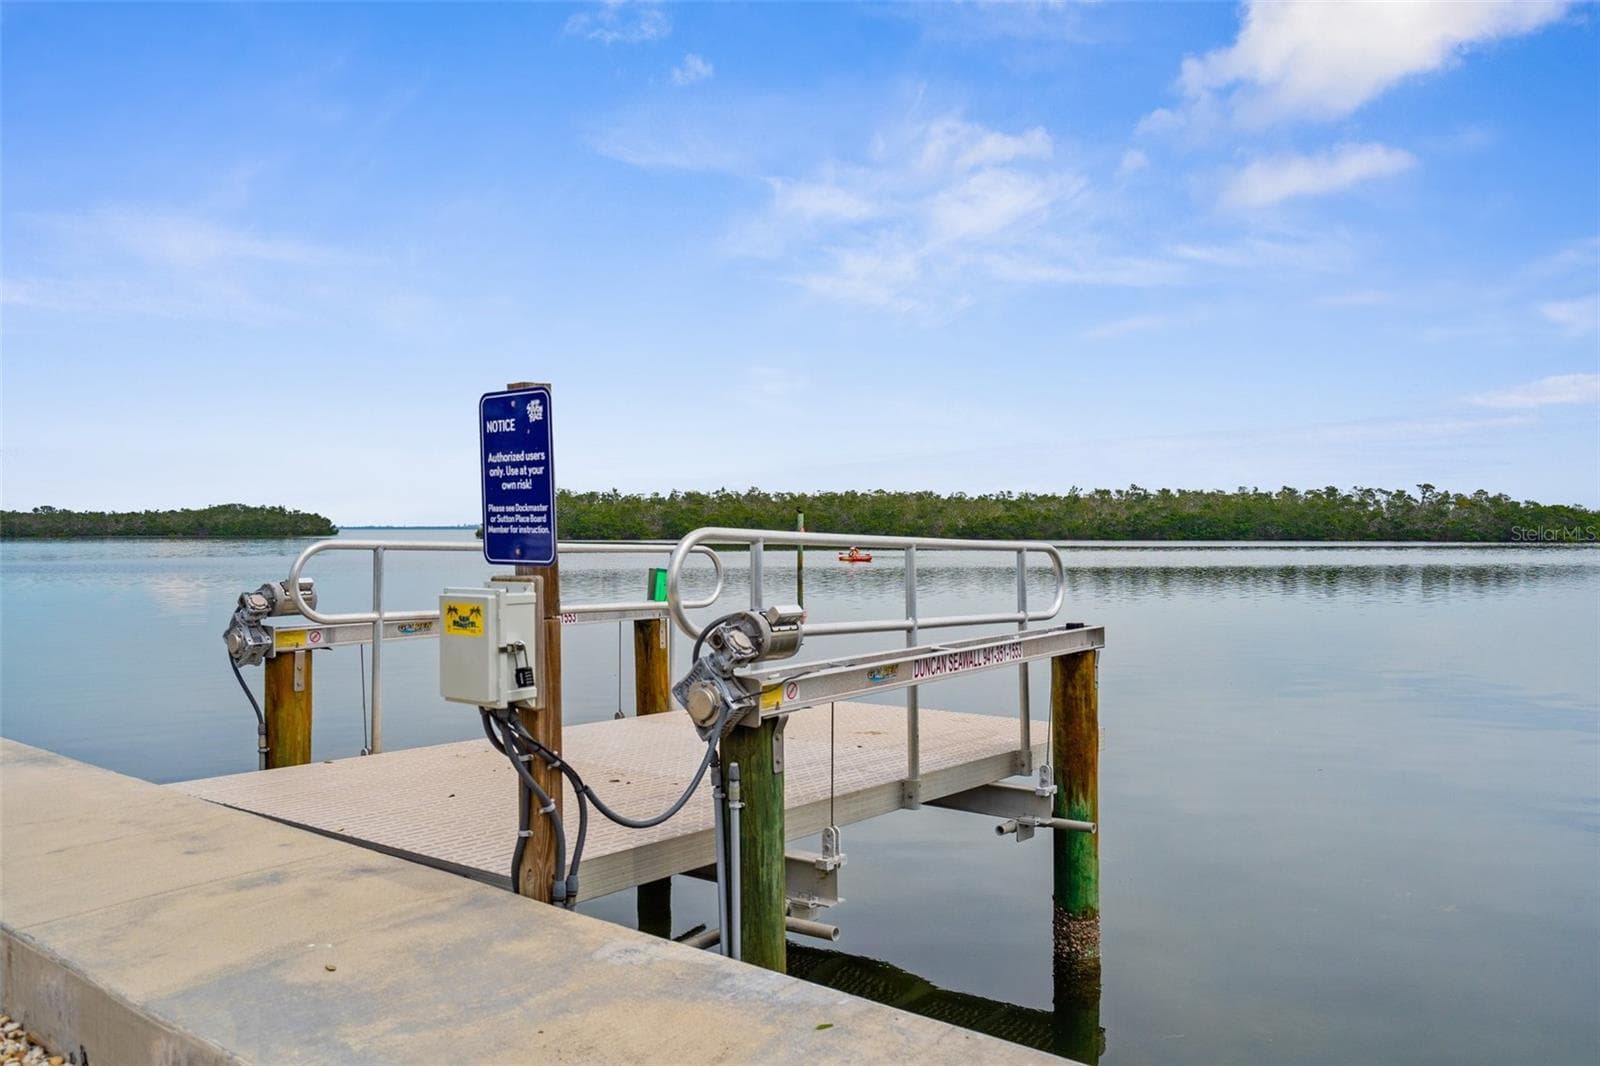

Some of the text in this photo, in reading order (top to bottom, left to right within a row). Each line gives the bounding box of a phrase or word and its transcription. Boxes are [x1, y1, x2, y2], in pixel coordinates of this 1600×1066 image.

[486, 418, 516, 433] NOTICE
[488, 450, 546, 463] Authorized users
[489, 464, 545, 479] only. Use at your
[501, 478, 533, 490] own risk!
[488, 503, 505, 513] Please
[515, 503, 549, 512] Dockmaster
[515, 514, 530, 523] Place
[530, 513, 547, 523] Board
[488, 525, 510, 534] Member
[510, 525, 519, 533] for
[914, 656, 948, 678] DUNCAN
[948, 648, 982, 672] SEAWALL
